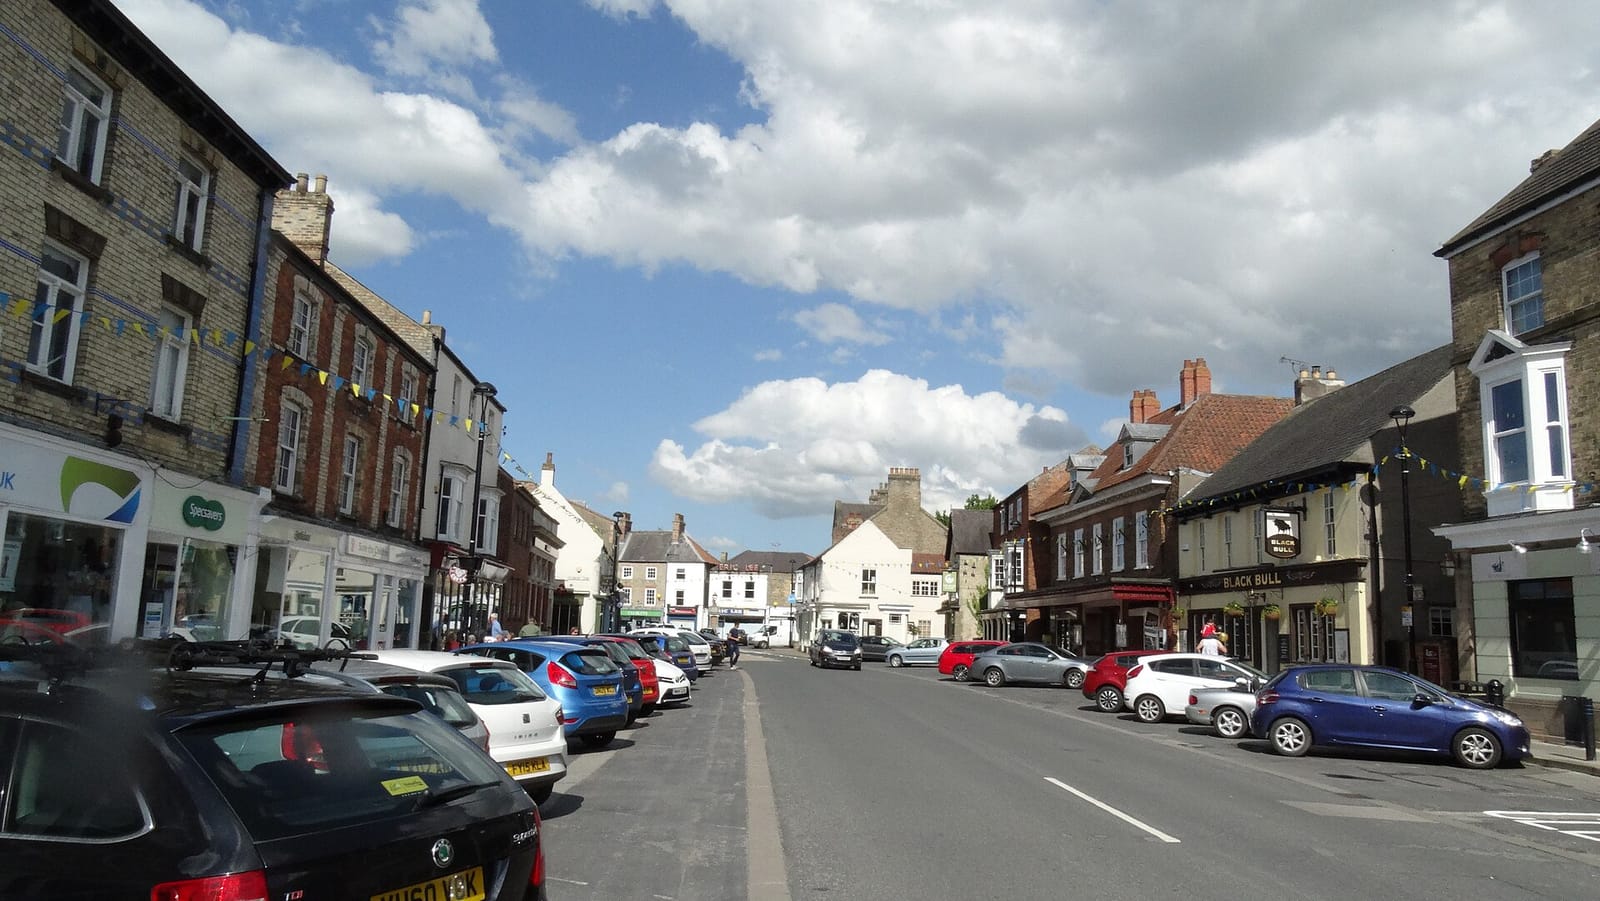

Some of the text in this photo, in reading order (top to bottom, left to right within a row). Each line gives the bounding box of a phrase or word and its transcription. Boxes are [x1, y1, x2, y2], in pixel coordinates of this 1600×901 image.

[190, 503, 223, 521] Specsavers
[718, 563, 759, 571] ERIC LEE
[1223, 572, 1281, 589] BLACK BULL
